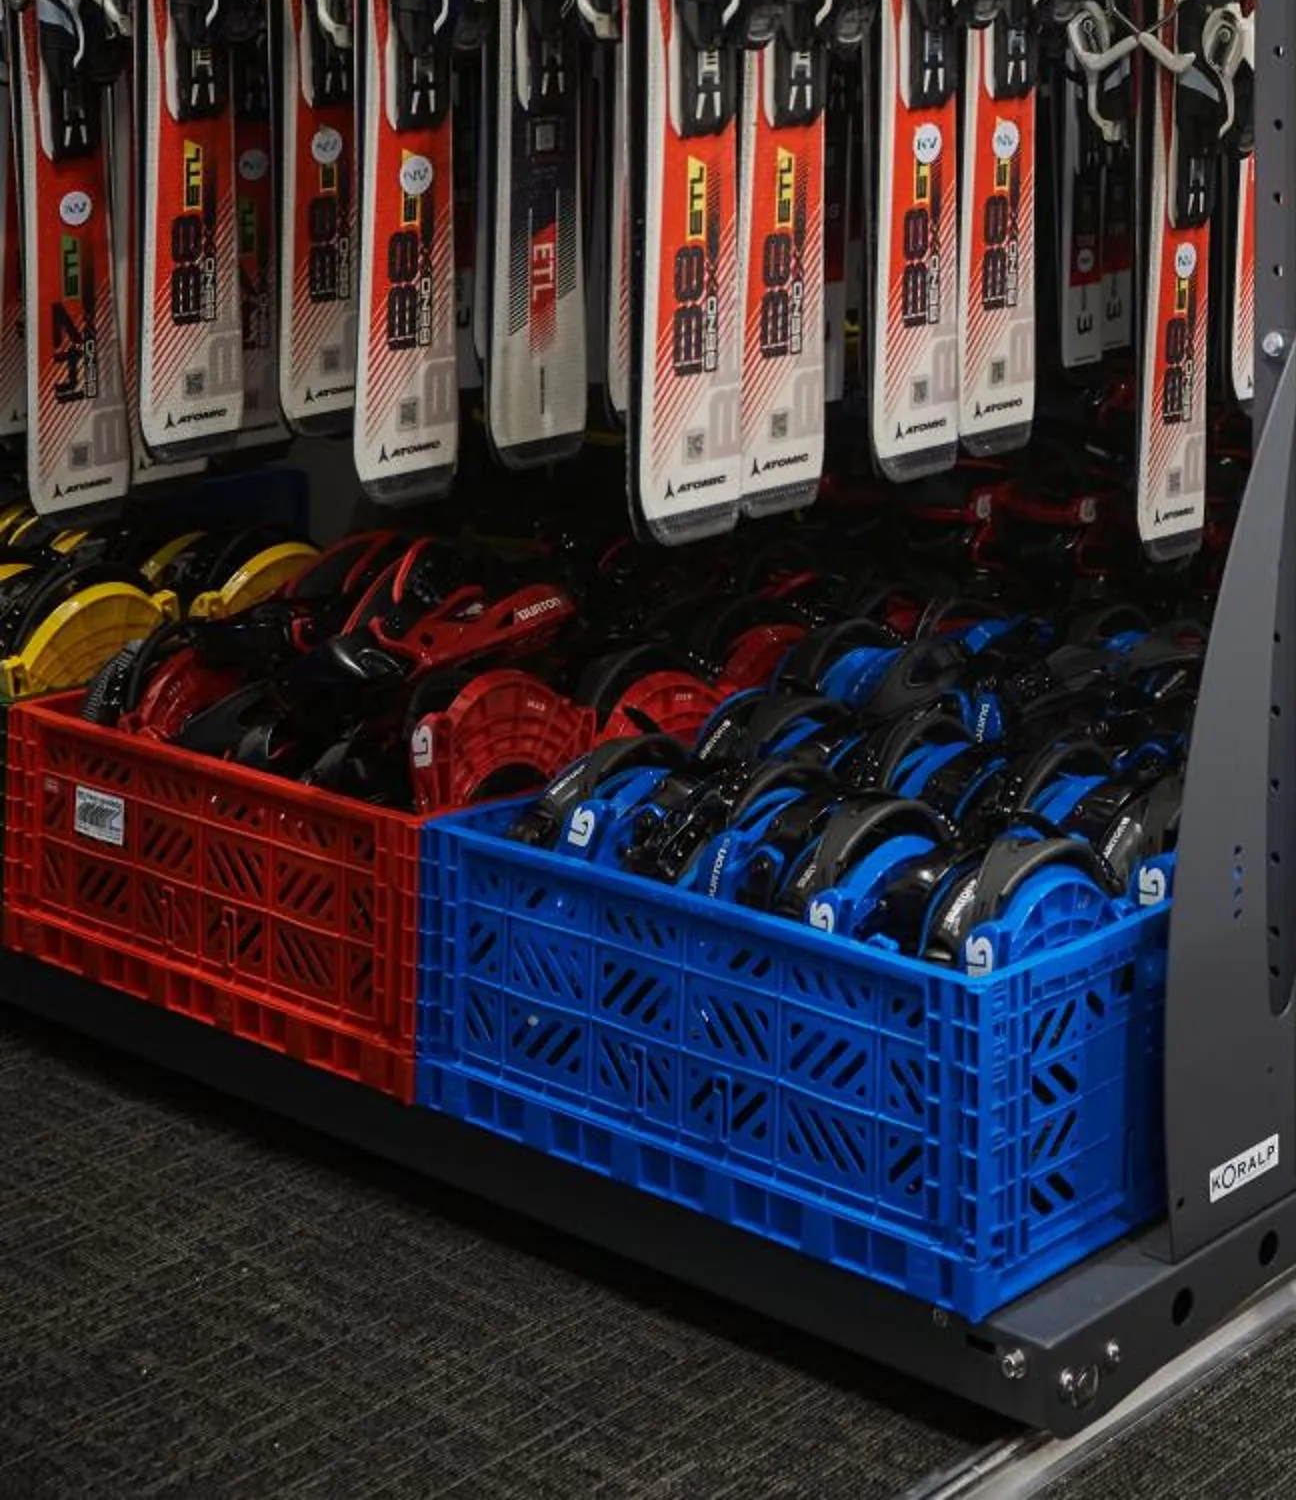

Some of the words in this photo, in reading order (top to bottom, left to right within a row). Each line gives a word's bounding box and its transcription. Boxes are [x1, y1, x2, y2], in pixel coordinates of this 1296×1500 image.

[184, 145, 202, 209] ETL
[916, 162, 928, 200] ET
[688, 162, 706, 238] ETL
[776, 154, 794, 225] ETL
[62, 236, 81, 299] ETL
[531, 242, 555, 300] ETL
[176, 408, 228, 426] ATOMIC
[984, 398, 1024, 414] ATOMIC
[904, 418, 947, 436] ATOMIC
[390, 440, 441, 458] ATOMIC
[762, 452, 809, 473] ATOMIC
[63, 476, 113, 496] ATOMIC
[676, 473, 727, 494] ATOMIC
[1162, 504, 1195, 518] ATOMIC
[515, 596, 561, 621] BURTON
[1212, 1145, 1275, 1193] KORALP
